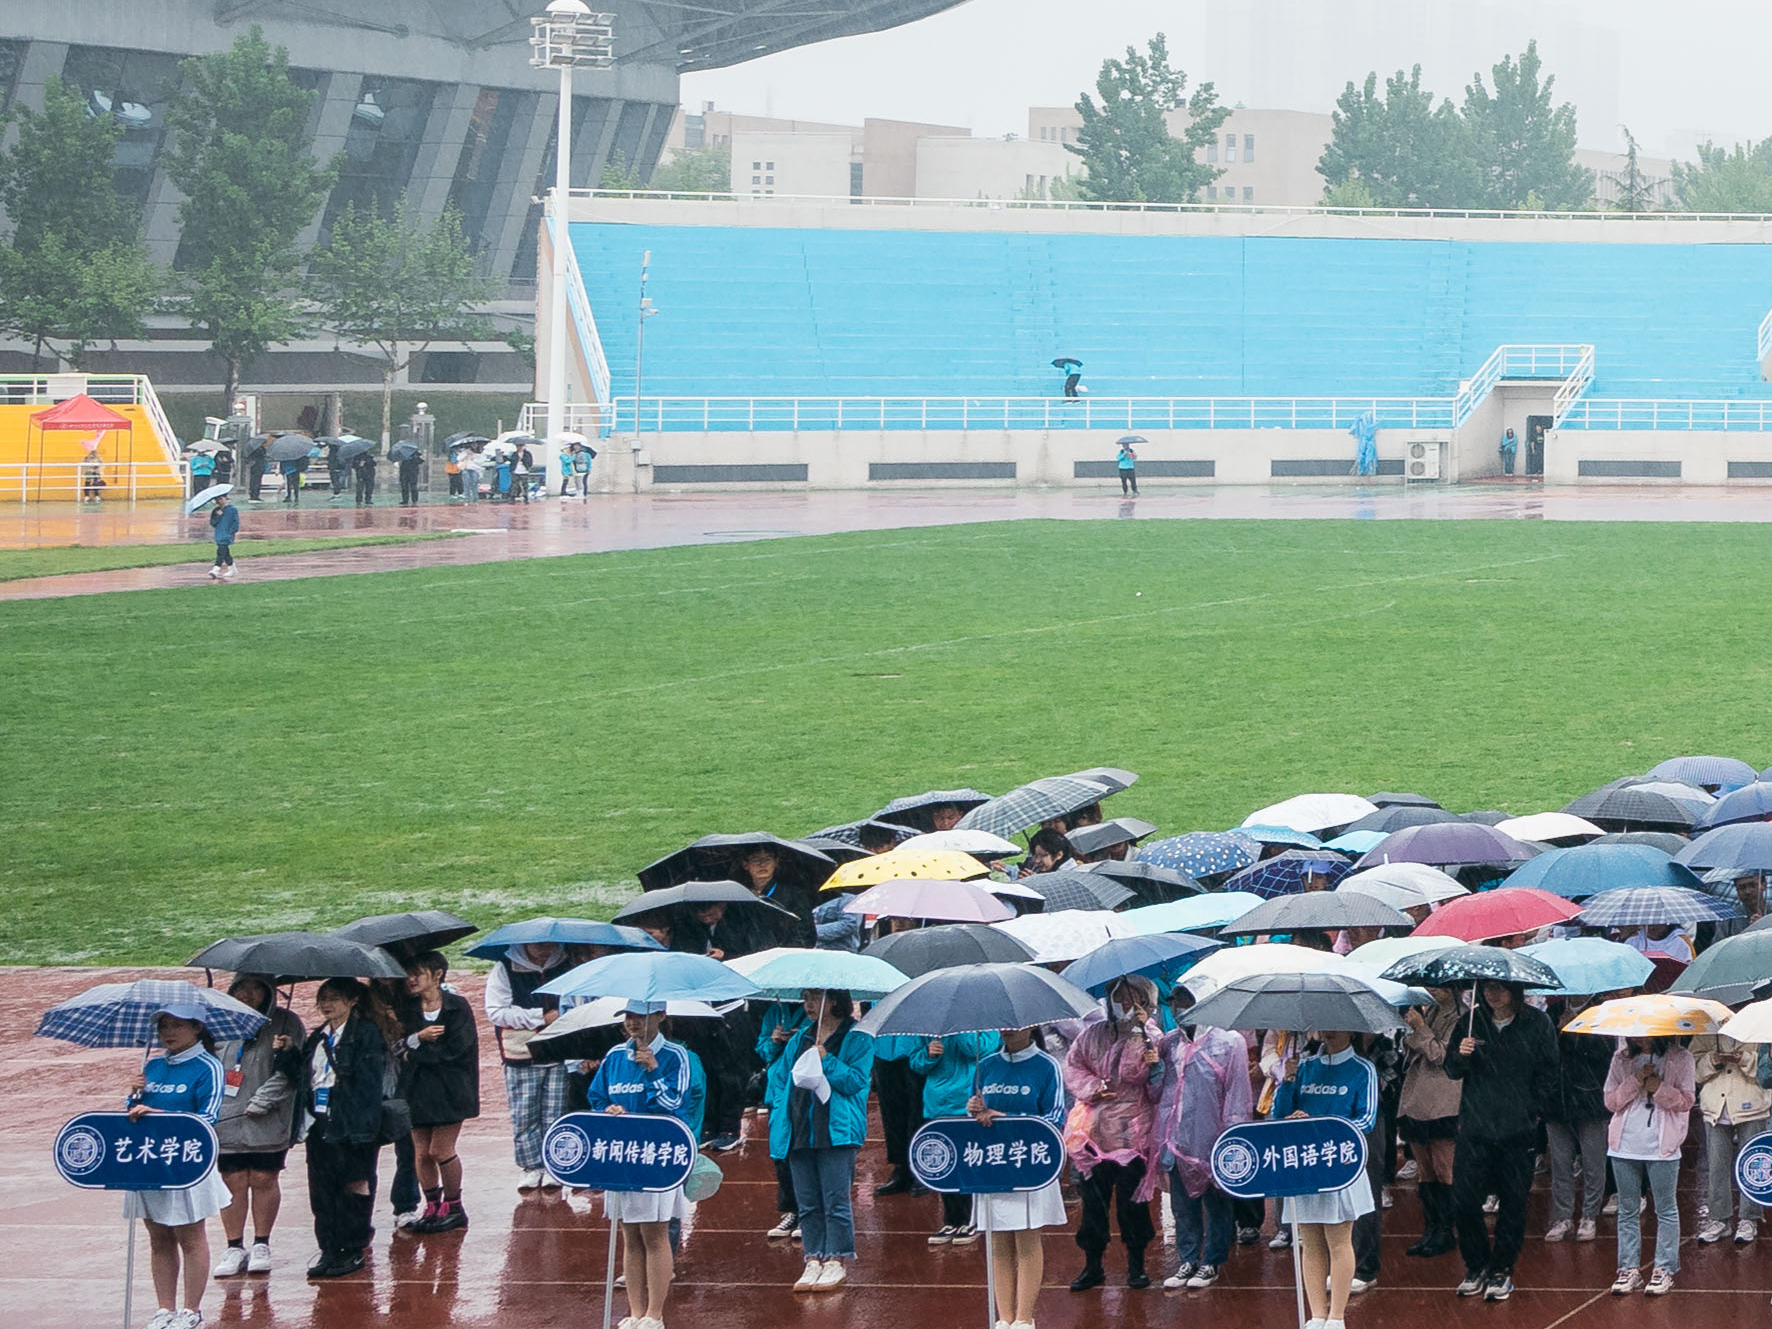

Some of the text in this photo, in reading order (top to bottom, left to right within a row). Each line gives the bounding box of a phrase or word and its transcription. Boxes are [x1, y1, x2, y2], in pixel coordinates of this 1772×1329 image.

[114, 1136, 203, 1166] 艺术学院
[592, 1138, 689, 1167] 新闻传播学院
[963, 1139, 1052, 1168] 物理学院
[1262, 1140, 1356, 1171] 外国语学院
